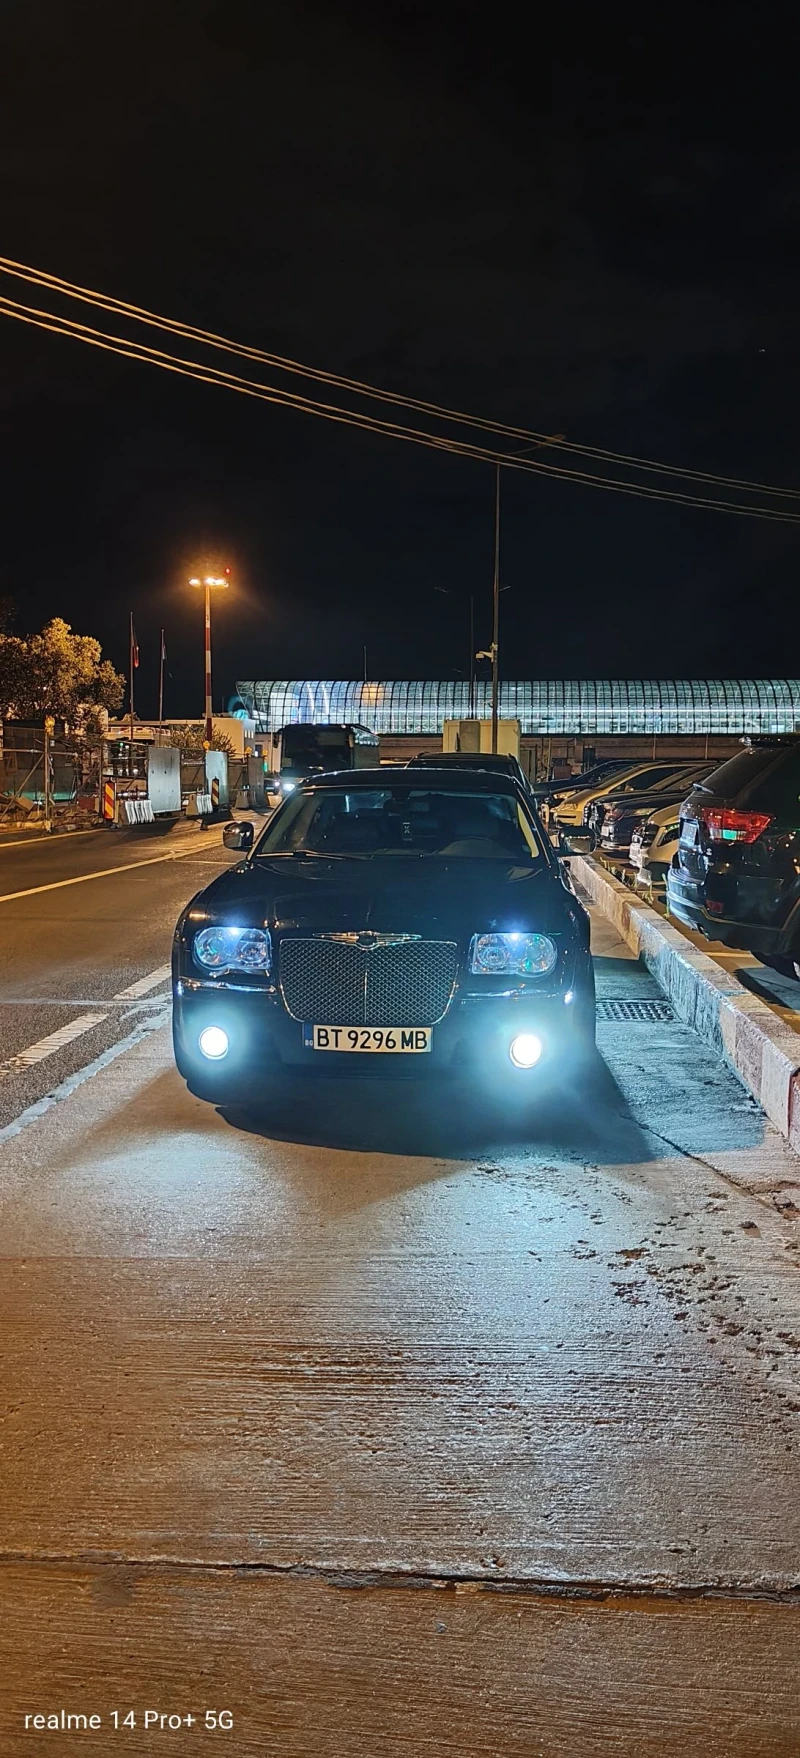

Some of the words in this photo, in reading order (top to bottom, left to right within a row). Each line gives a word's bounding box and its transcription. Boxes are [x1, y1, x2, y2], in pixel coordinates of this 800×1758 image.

[317, 1028, 343, 1048] BT
[347, 1030, 397, 1050] 9296
[400, 1031, 428, 1050] MB
